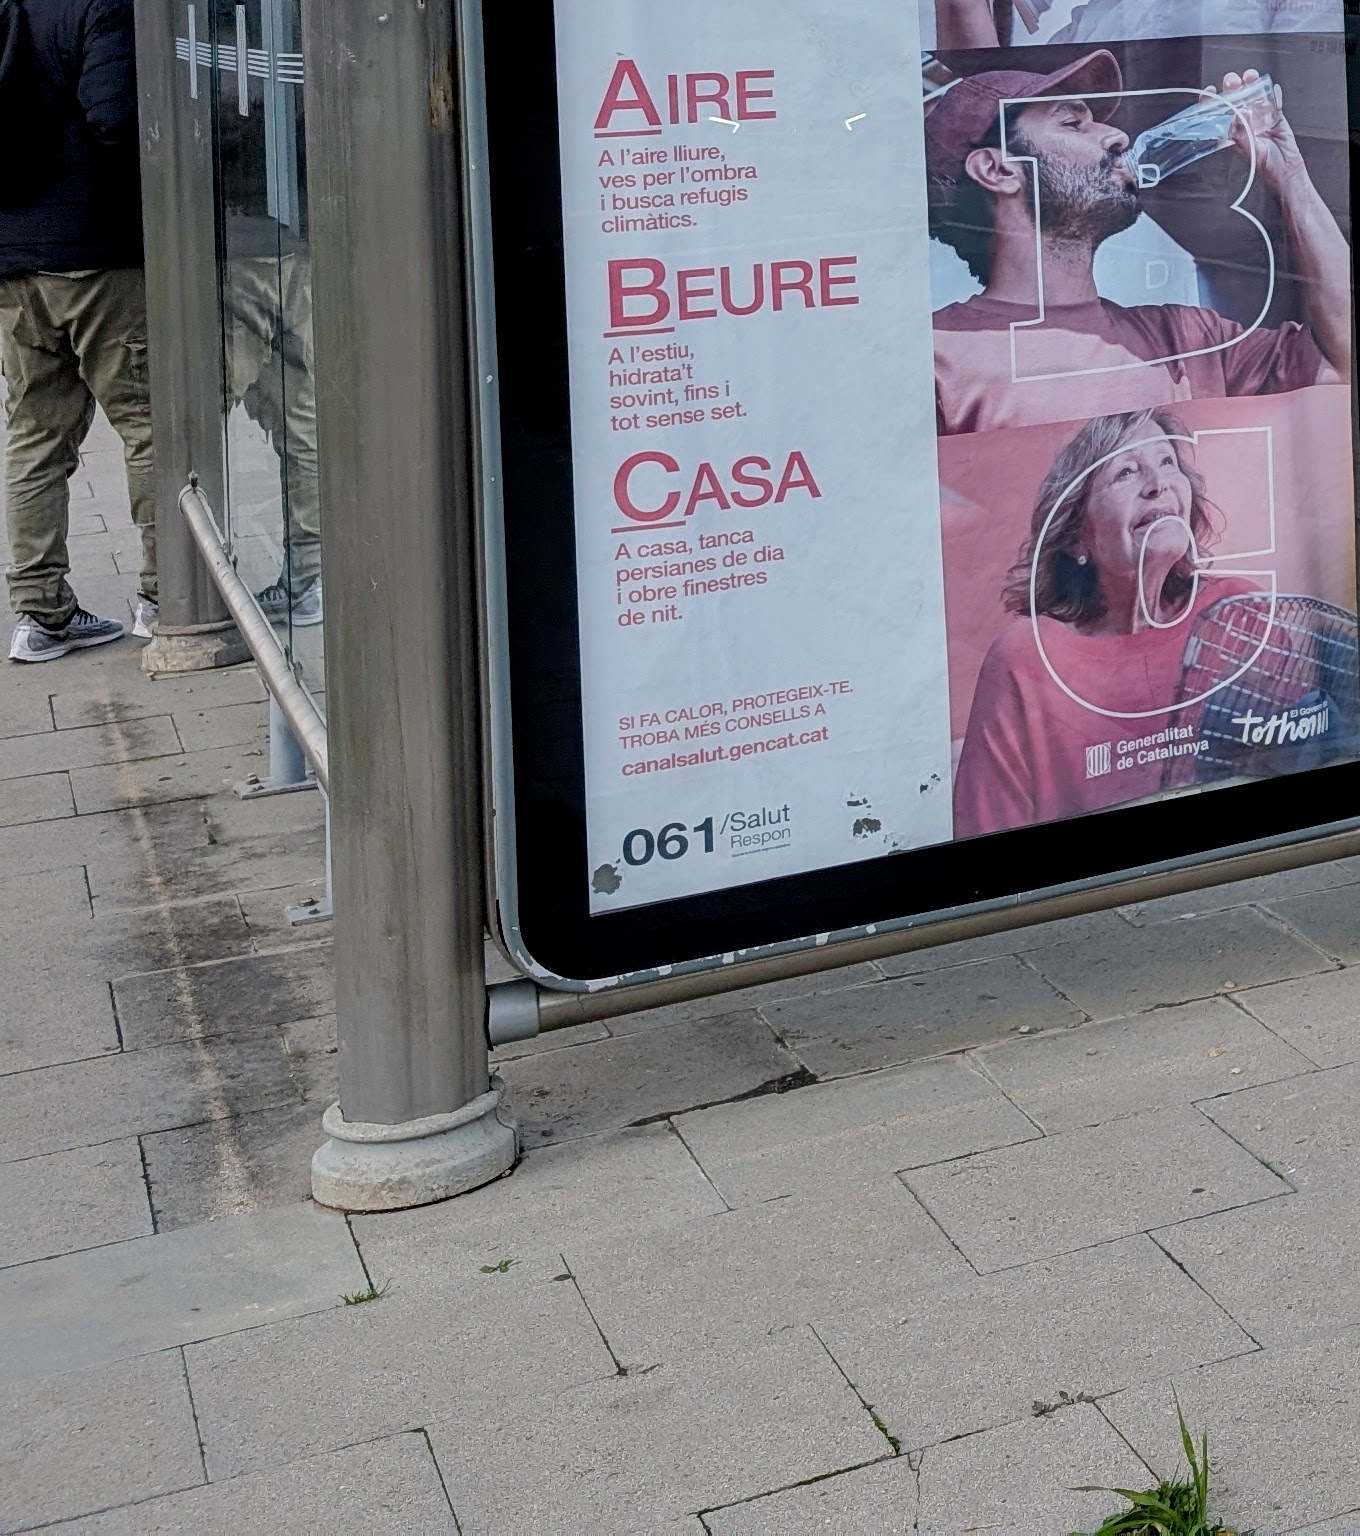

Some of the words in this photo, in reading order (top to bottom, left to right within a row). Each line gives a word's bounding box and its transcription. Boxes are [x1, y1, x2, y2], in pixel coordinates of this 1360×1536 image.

[593, 59, 777, 129] AIRE
[598, 149, 615, 167] A
[620, 147, 668, 166] l'aire
[673, 144, 726, 163] lliure,
[599, 173, 637, 189] ves
[643, 170, 675, 191] per
[680, 163, 757, 184] l'ombra
[600, 194, 606, 211] i
[612, 191, 675, 211] busca
[680, 186, 749, 207] refugis
[601, 212, 697, 233] climàtics.
[607, 256, 859, 329] BEURE
[608, 347, 625, 365] A
[610, 388, 679, 409] sovint,
[684, 384, 720, 403] fins
[725, 380, 730, 398] i
[611, 414, 642, 432] tot
[645, 409, 705, 428] sense
[710, 401, 748, 420] set.
[613, 450, 822, 522] CASA
[614, 543, 631, 561] A
[637, 538, 692, 560] casa,
[698, 529, 754, 551] tanca
[616, 557, 717, 586] persianes
[722, 549, 748, 568] de
[754, 544, 785, 563] dia
[617, 589, 622, 606] i
[628, 582, 677, 604] obre
[682, 569, 768, 597] finestres
[617, 609, 646, 628] de
[651, 604, 683, 624] nit.
[619, 715, 635, 731] SI
[640, 713, 661, 728] FA
[665, 702, 728, 725] CALOR,
[732, 680, 854, 713] PROTEGEIX-TE.
[619, 731, 680, 750] TROBA
[684, 720, 721, 740] MÉS
[724, 704, 811, 732] CONSELLS
[814, 702, 827, 716] A
[1116, 725, 1194, 755] Generalitat
[621, 726, 830, 776] canalsalut.gencat.cat
[1116, 755, 1134, 771] de
[1137, 738, 1210, 764] Catalunya
[622, 817, 716, 866] 061
[730, 828, 791, 849] Respon
